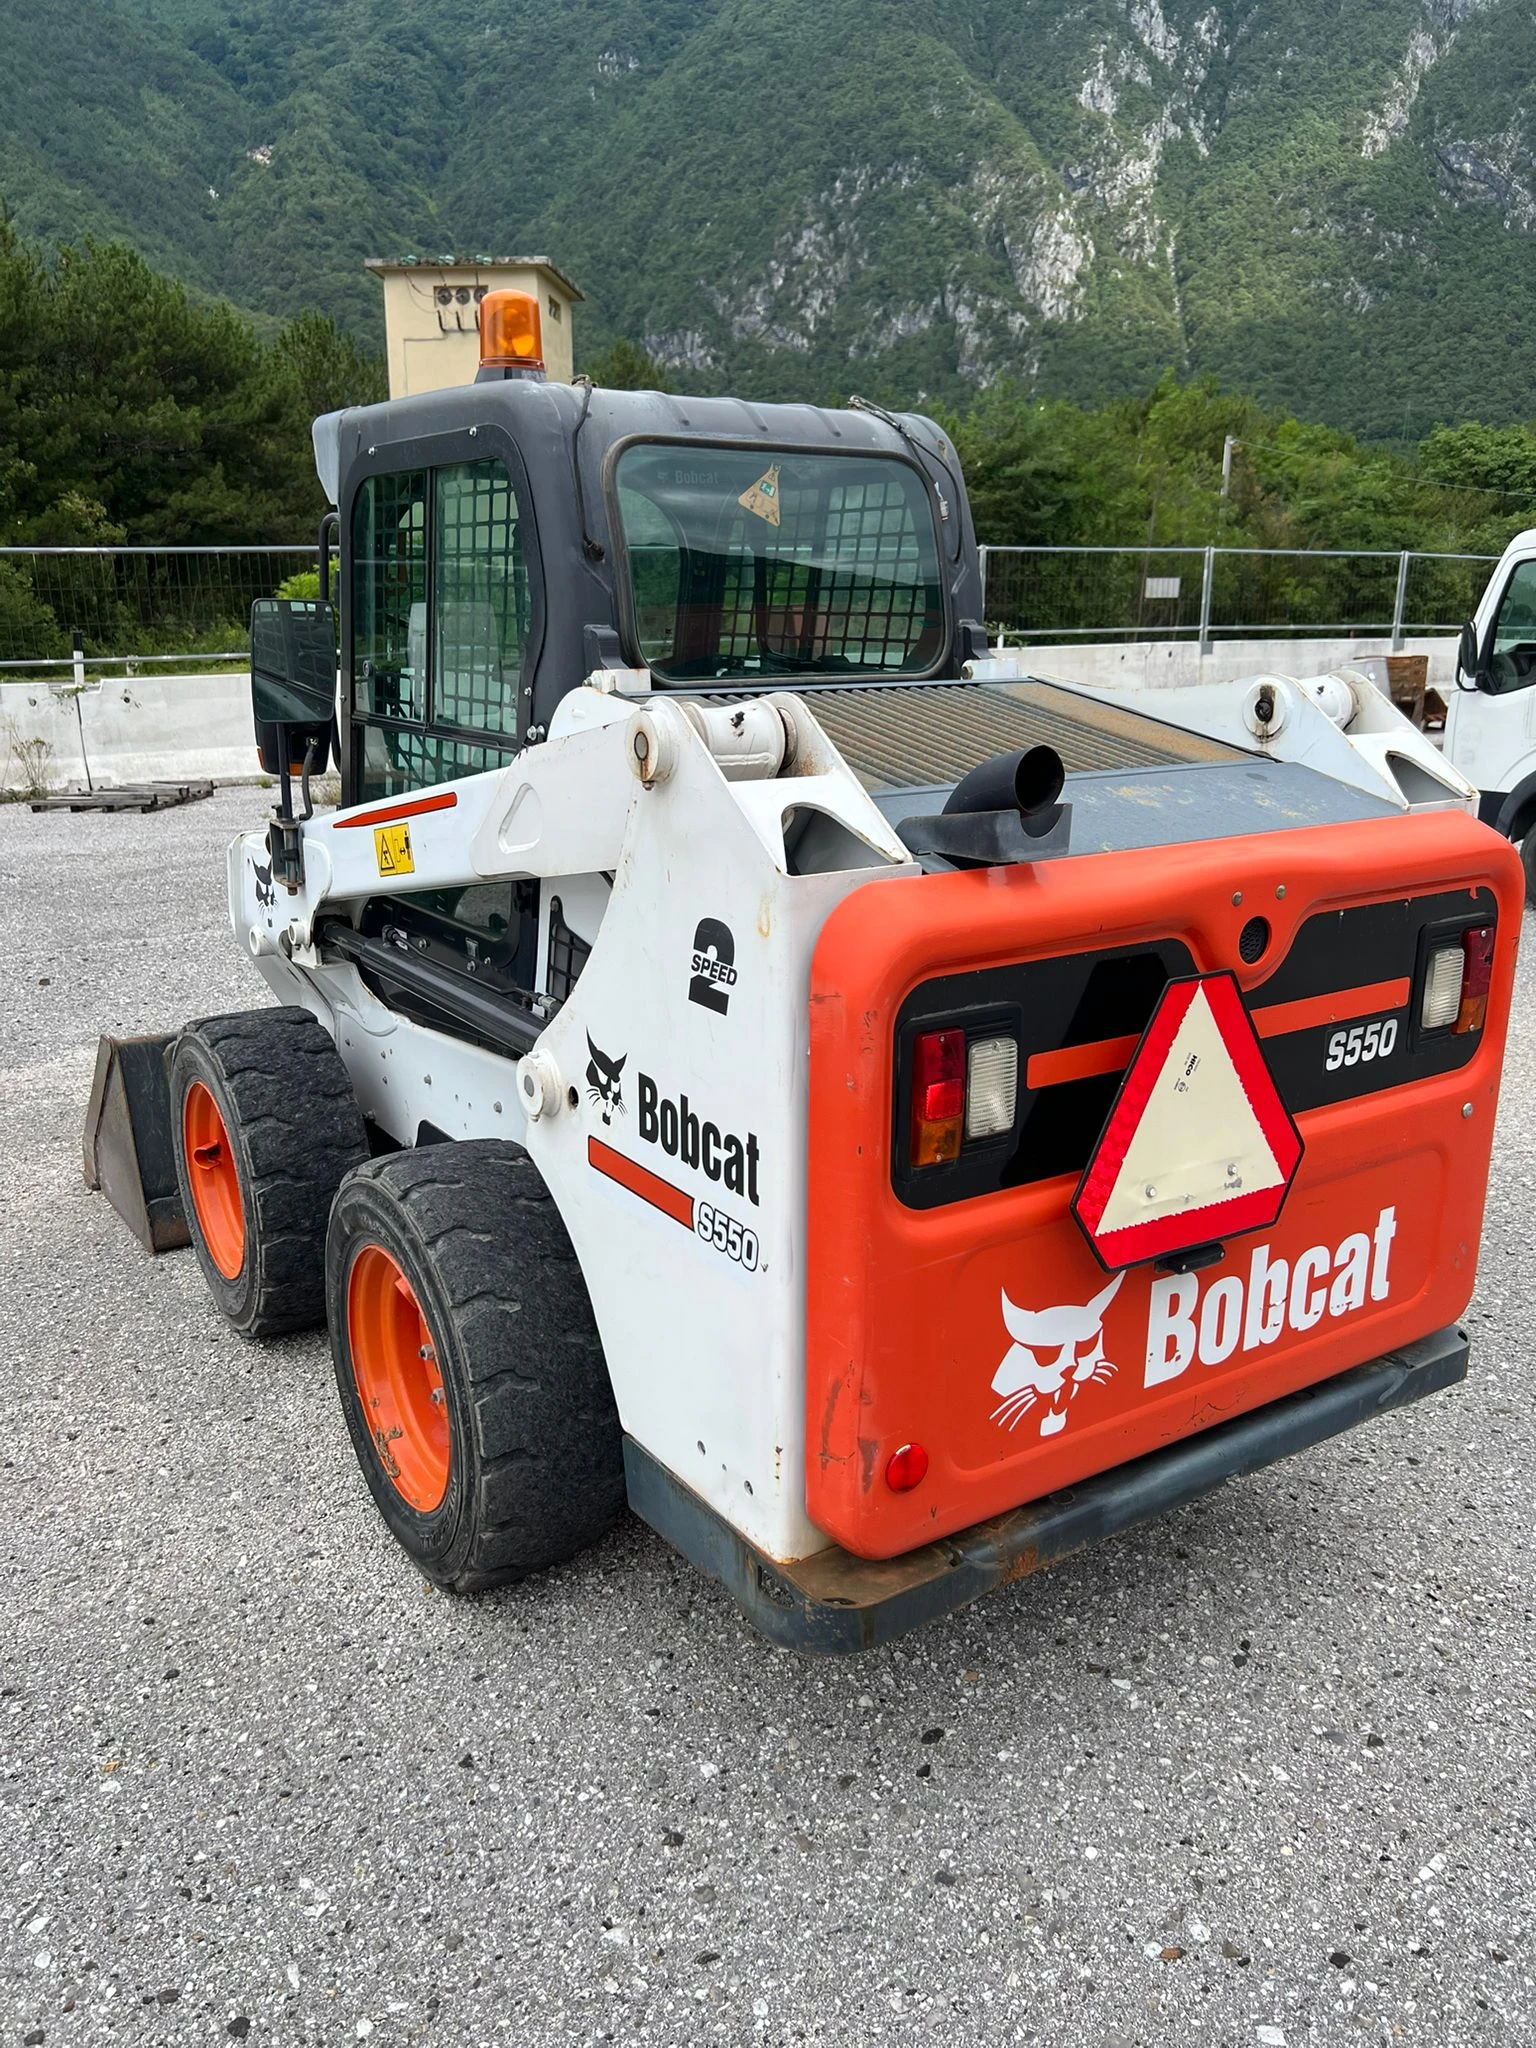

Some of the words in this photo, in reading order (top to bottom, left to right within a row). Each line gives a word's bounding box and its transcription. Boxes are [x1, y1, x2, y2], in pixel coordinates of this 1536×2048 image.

[688, 917, 735, 1016] 2
[690, 953, 738, 986] SPEED
[1325, 1018, 1398, 1072] S550
[638, 1071, 760, 1207] Bobcat
[697, 1201, 760, 1272] S550
[1143, 1205, 1397, 1389] Bobcat
